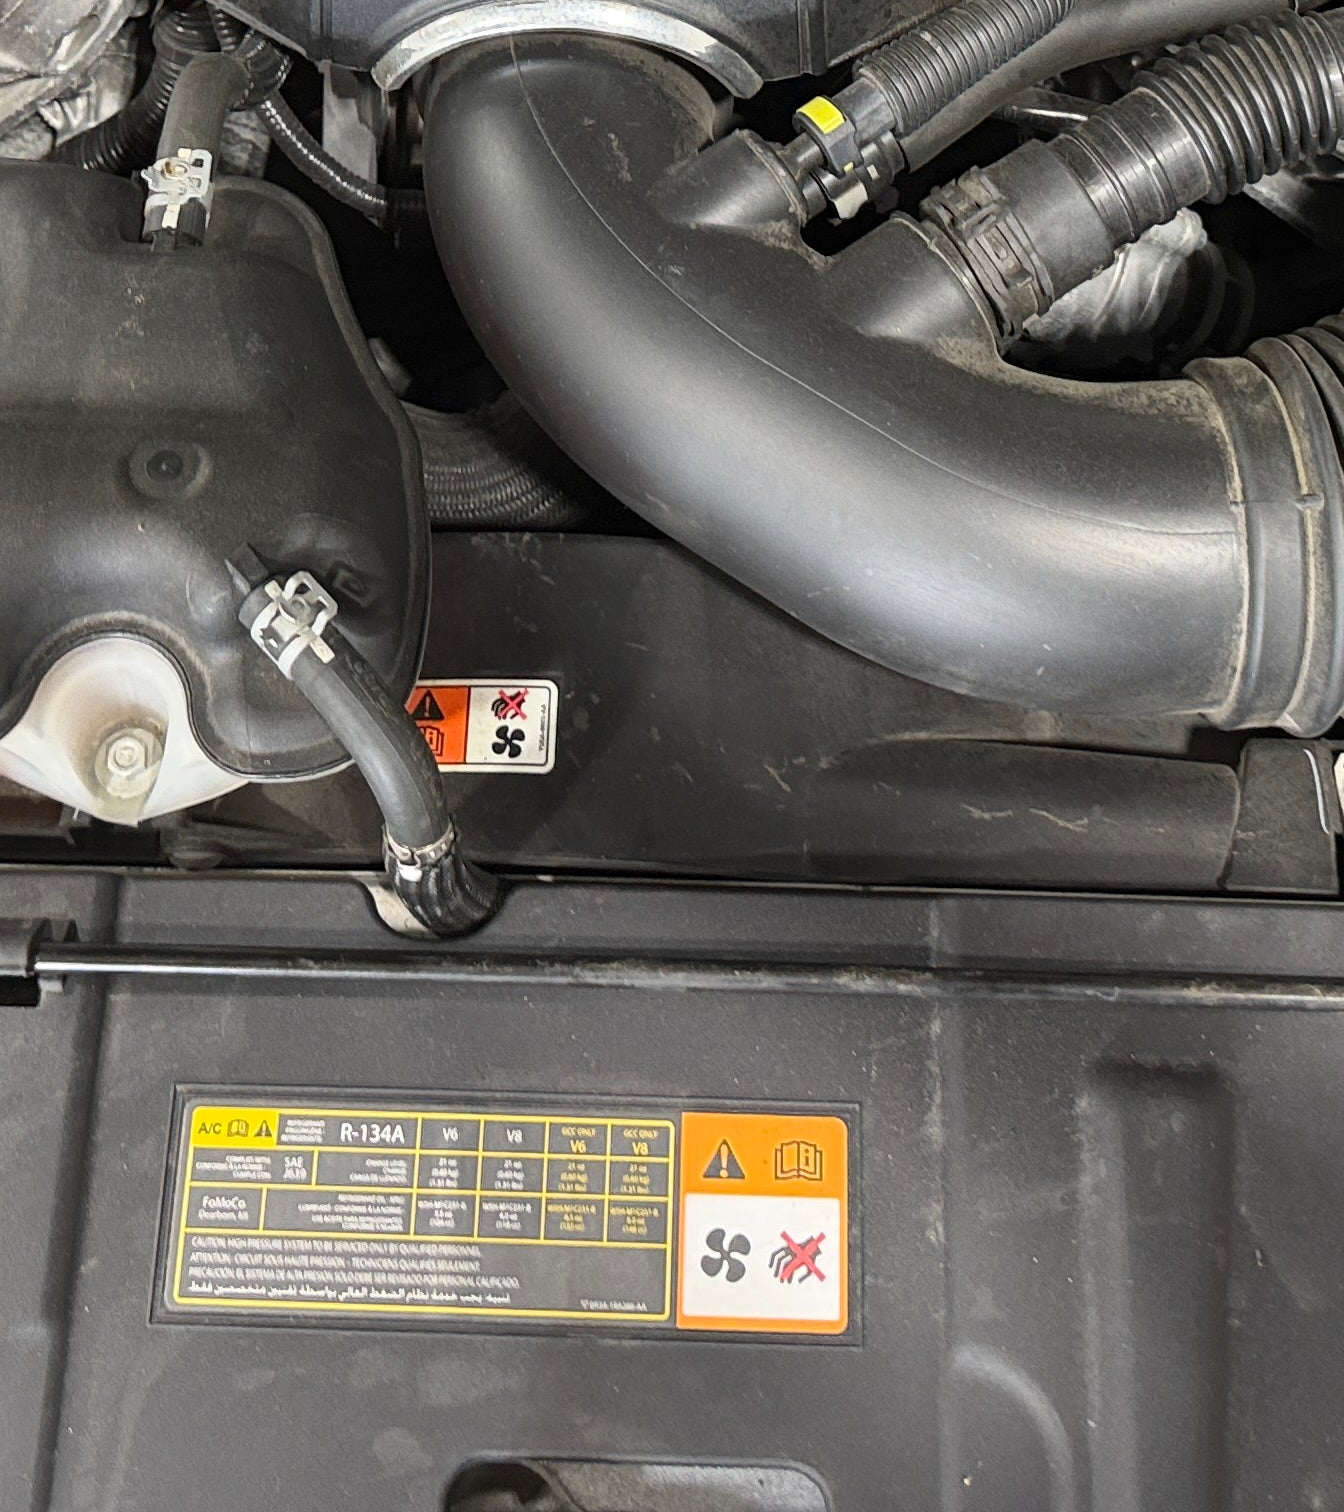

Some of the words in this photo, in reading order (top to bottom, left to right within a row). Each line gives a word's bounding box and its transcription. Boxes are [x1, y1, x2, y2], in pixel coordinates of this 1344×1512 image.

[197, 1122, 223, 1135] A/C
[340, 1122, 405, 1144] R-134A
[443, 1126, 459, 1142] V6
[506, 1128, 523, 1144] V8
[570, 1139, 587, 1153] V6
[632, 1142, 649, 1156] V8
[202, 1195, 247, 1210] FoMoCo
